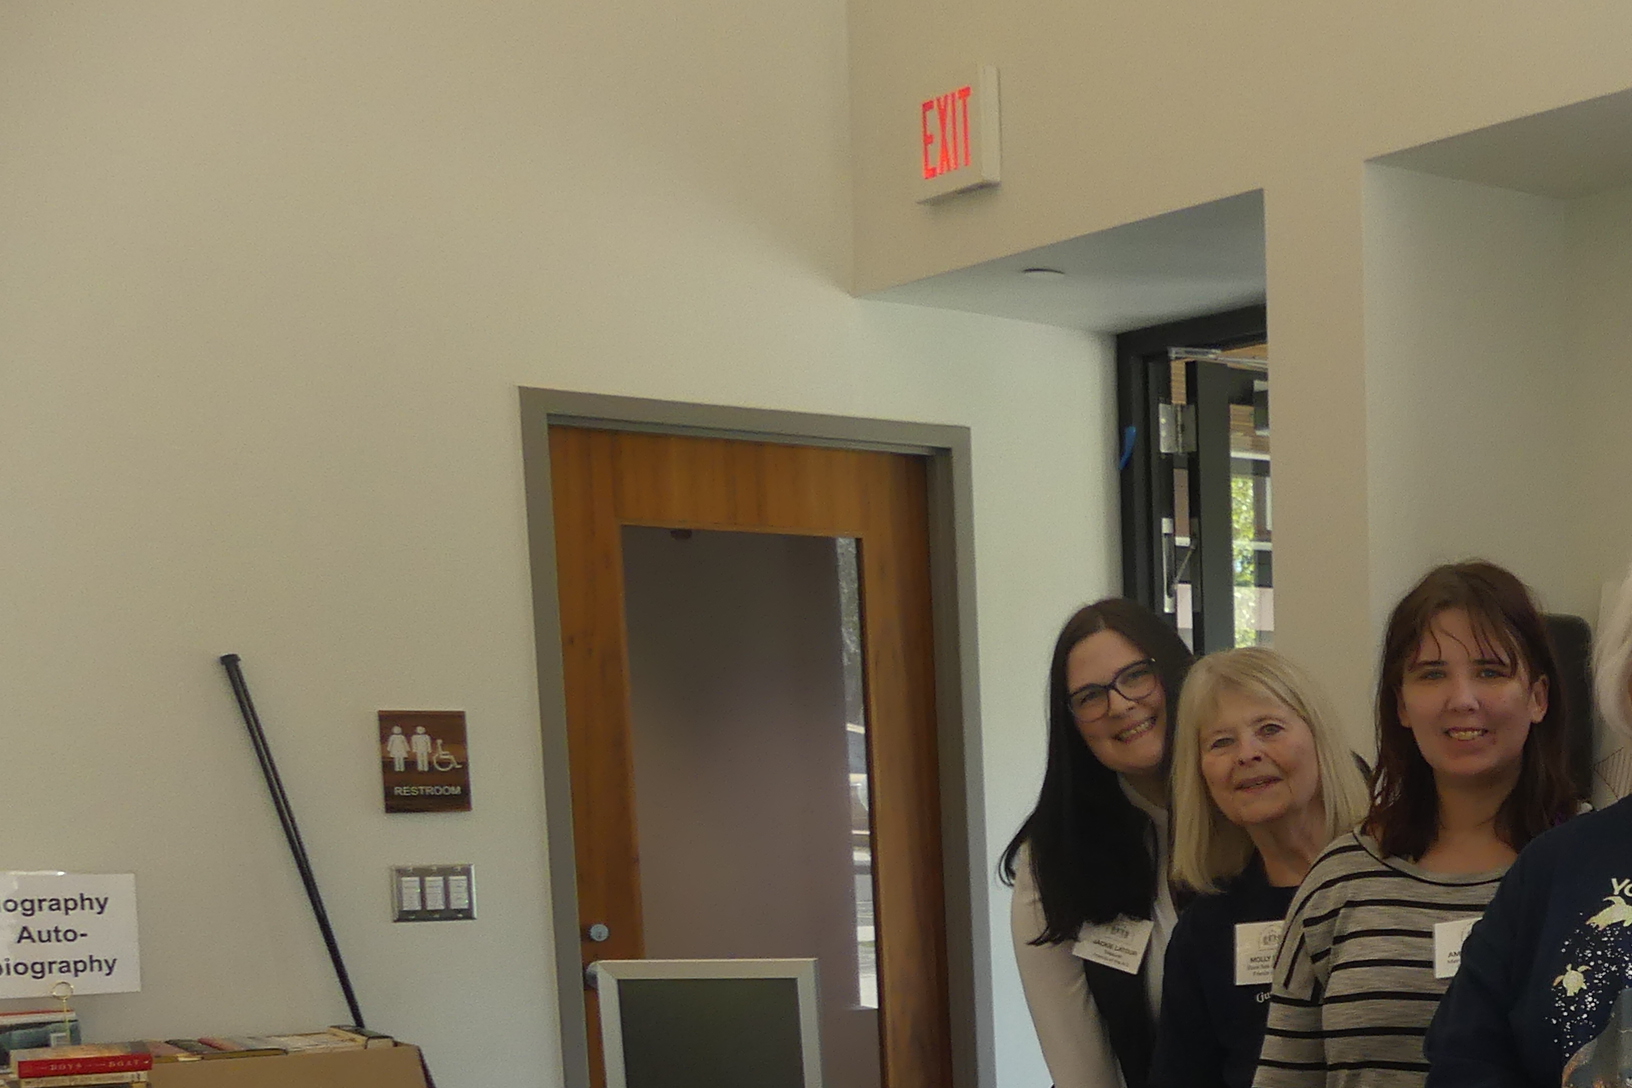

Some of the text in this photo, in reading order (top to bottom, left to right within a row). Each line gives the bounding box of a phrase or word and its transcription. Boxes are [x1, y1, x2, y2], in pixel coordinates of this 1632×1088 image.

[921, 86, 972, 180] EXIT
[393, 785, 462, 797] RESTROOM
[0, 892, 109, 917] ography
[17, 925, 88, 944] Auto-
